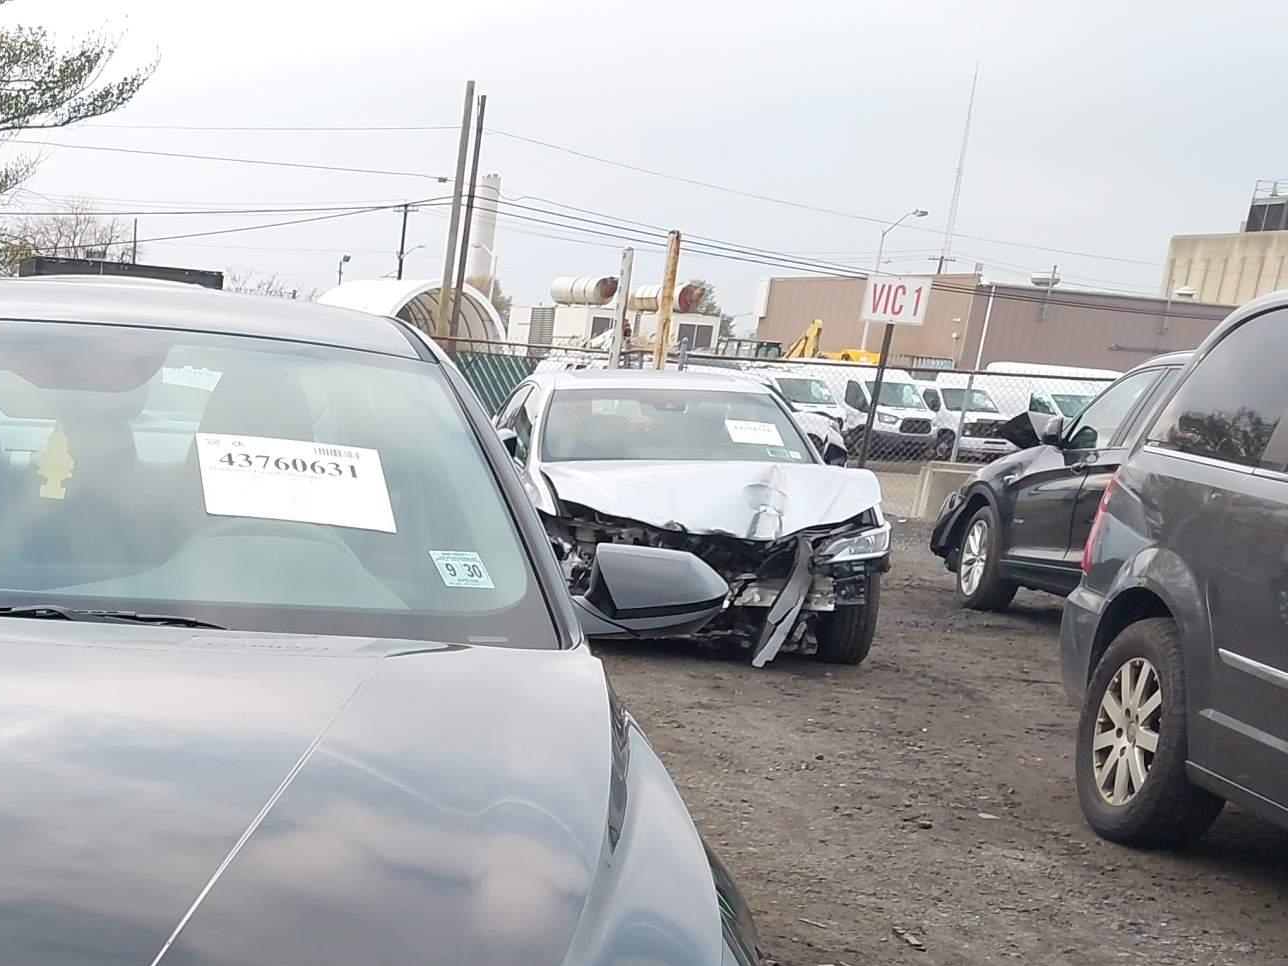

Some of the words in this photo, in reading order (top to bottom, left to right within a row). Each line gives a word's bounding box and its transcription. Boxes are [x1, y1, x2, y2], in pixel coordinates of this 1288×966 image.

[872, 283, 907, 316] VIC
[913, 286, 923, 317] 1
[219, 452, 360, 479] 43760631
[445, 563, 457, 577] 9
[463, 563, 483, 578] 30
